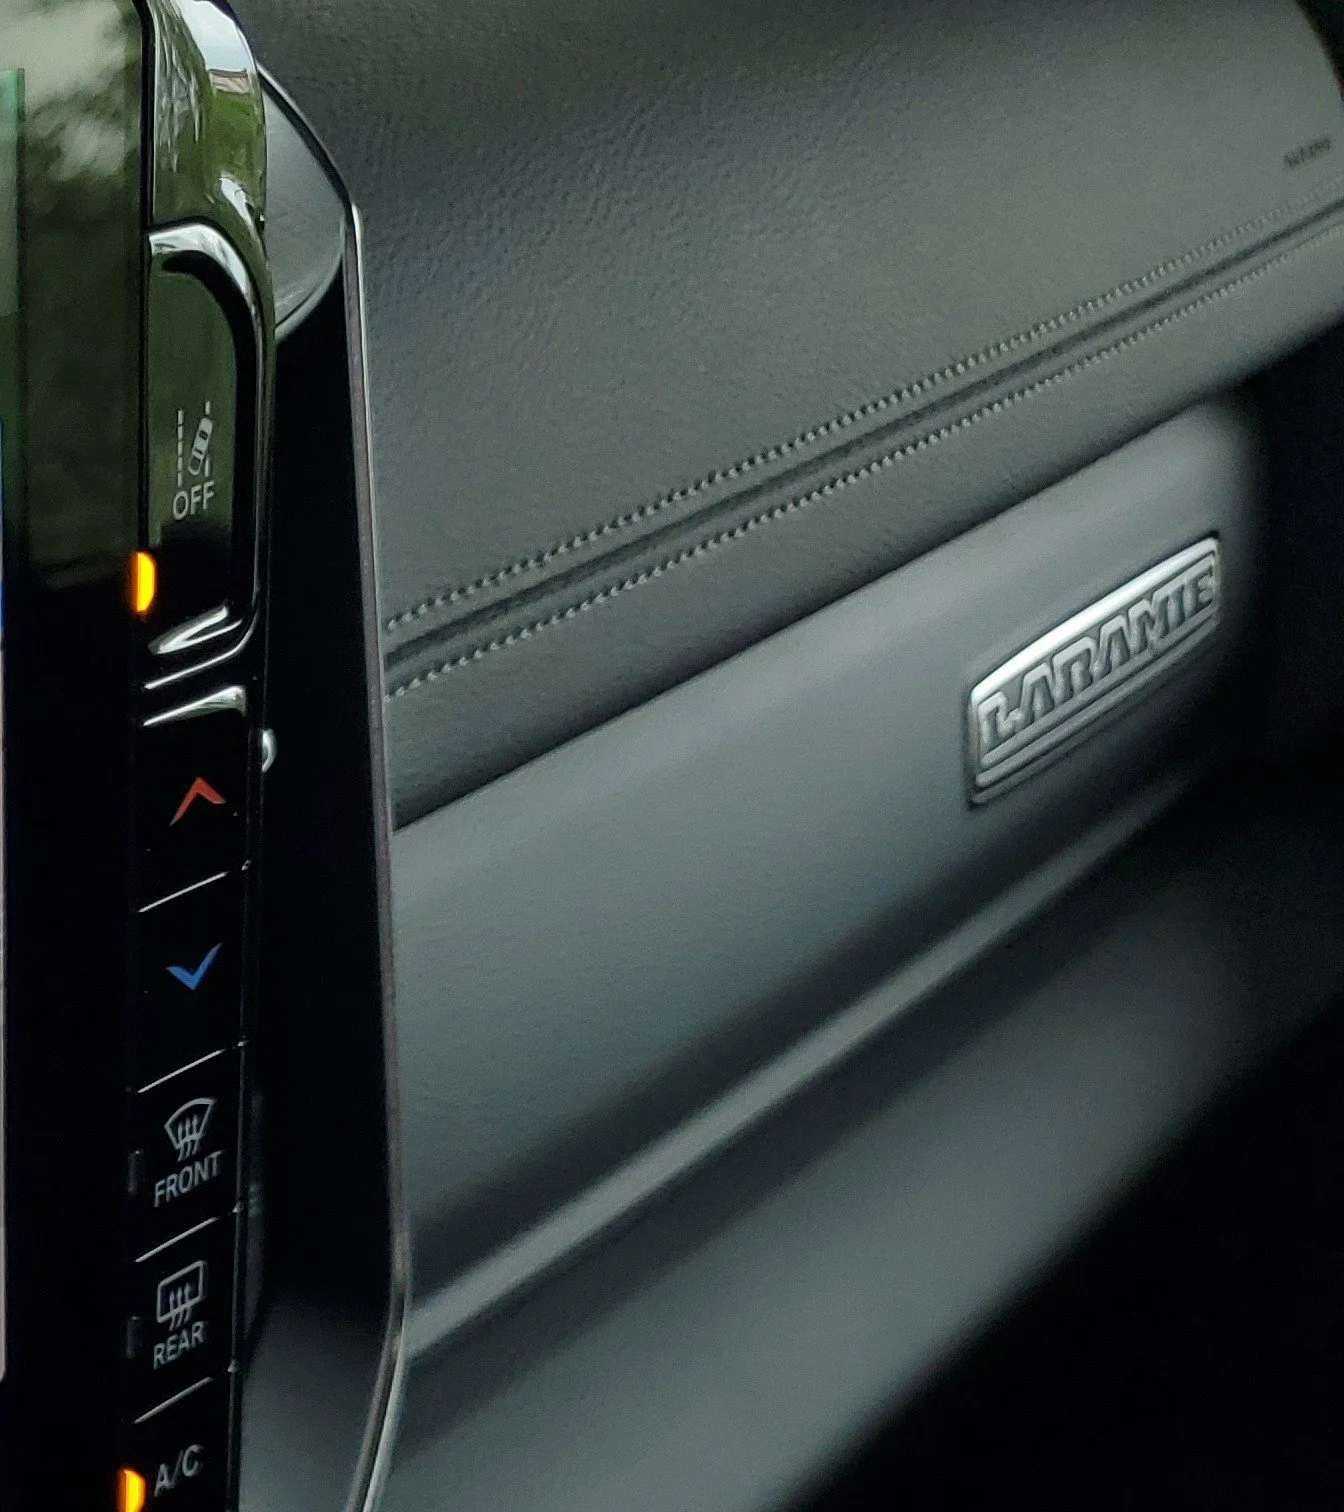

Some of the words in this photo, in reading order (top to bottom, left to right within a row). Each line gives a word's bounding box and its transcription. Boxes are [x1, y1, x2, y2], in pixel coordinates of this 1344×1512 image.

[172, 480, 214, 521] OFF
[154, 1150, 224, 1206] FRONT
[153, 1321, 205, 1369] REAR
[154, 1444, 203, 1498] A/C
